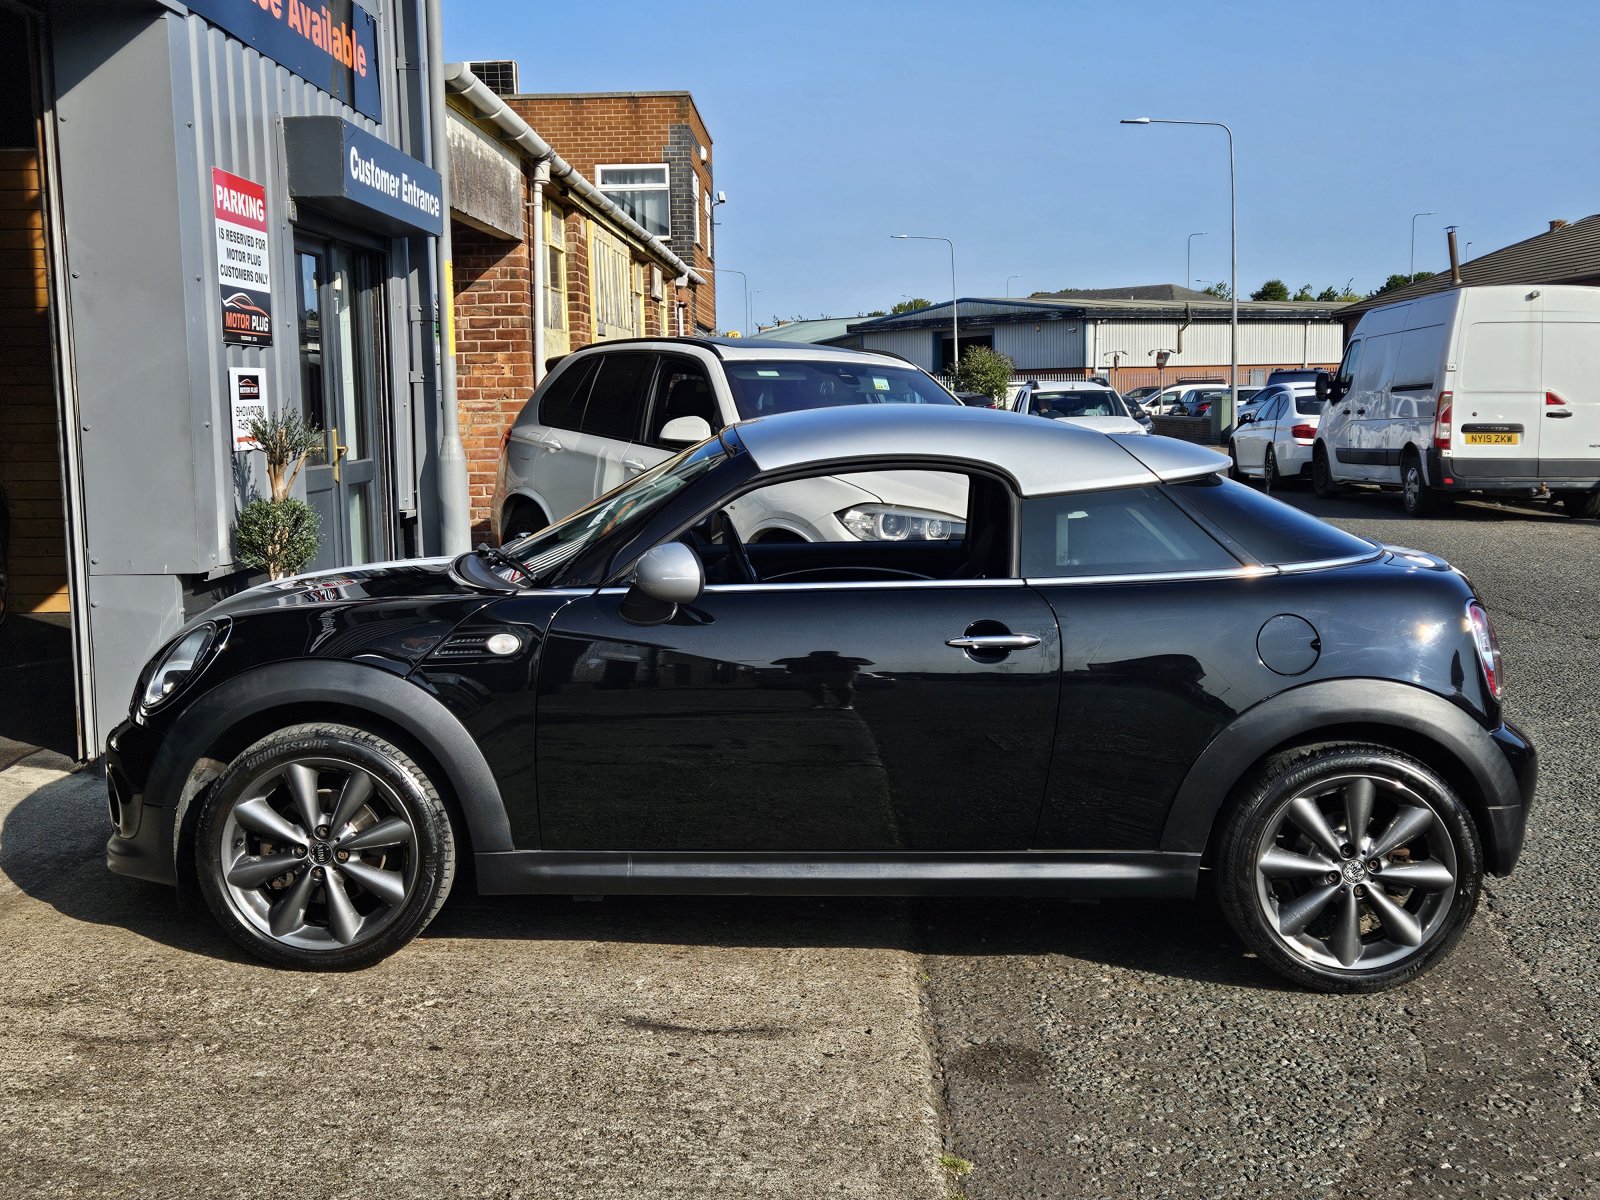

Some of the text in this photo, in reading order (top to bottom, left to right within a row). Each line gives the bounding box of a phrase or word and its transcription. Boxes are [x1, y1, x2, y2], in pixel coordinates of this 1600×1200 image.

[288, 0, 366, 77] Available
[349, 146, 440, 218] Customer Entrance
[215, 184, 265, 222] PARKING
[218, 226, 266, 251] IS RESERVED FOR
[226, 247, 262, 267] MOTOR PLUG
[220, 264, 269, 285] CUSTOMERS ONLY
[225, 311, 269, 332] MOTOR PLUG
[1471, 434, 1513, 443] NY19 ZKW
